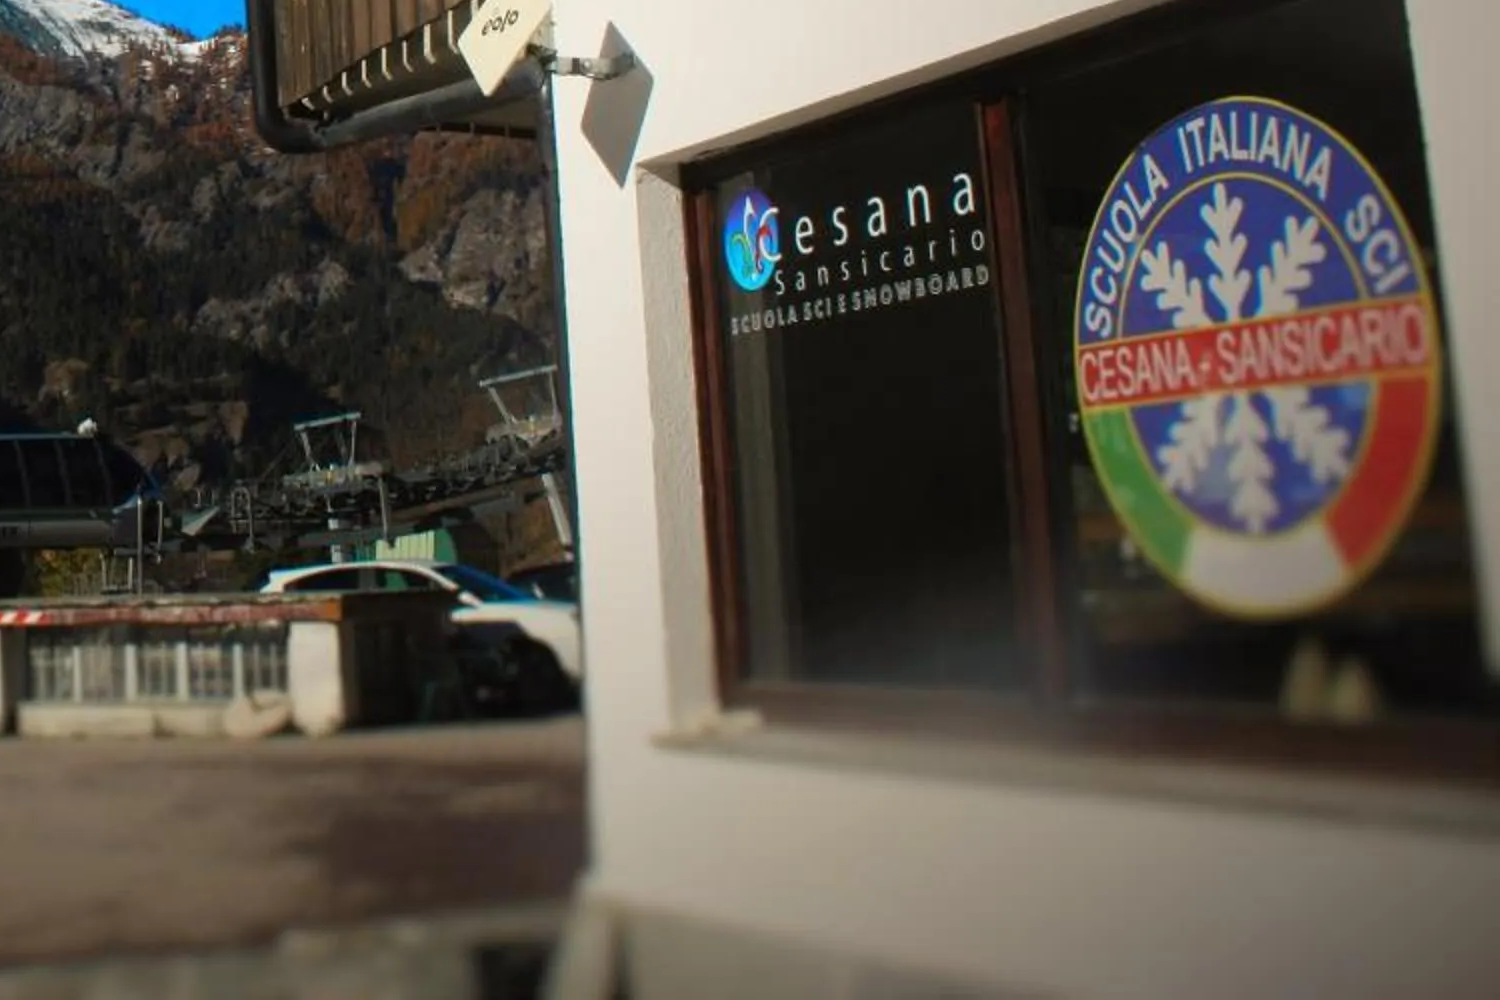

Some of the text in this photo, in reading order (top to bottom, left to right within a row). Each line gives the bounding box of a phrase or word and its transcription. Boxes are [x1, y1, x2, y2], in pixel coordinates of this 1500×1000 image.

[481, 9, 519, 36] eolo
[759, 171, 977, 262] Cesana
[1084, 111, 1410, 338] SCUOLA ITALIANA SCI
[730, 308, 798, 336] SCUOLA
[802, 300, 832, 322] SCI
[851, 263, 990, 312] SNOWBOARD
[774, 228, 986, 296] Sansicario
[1215, 304, 1427, 384] SANSICARIO
